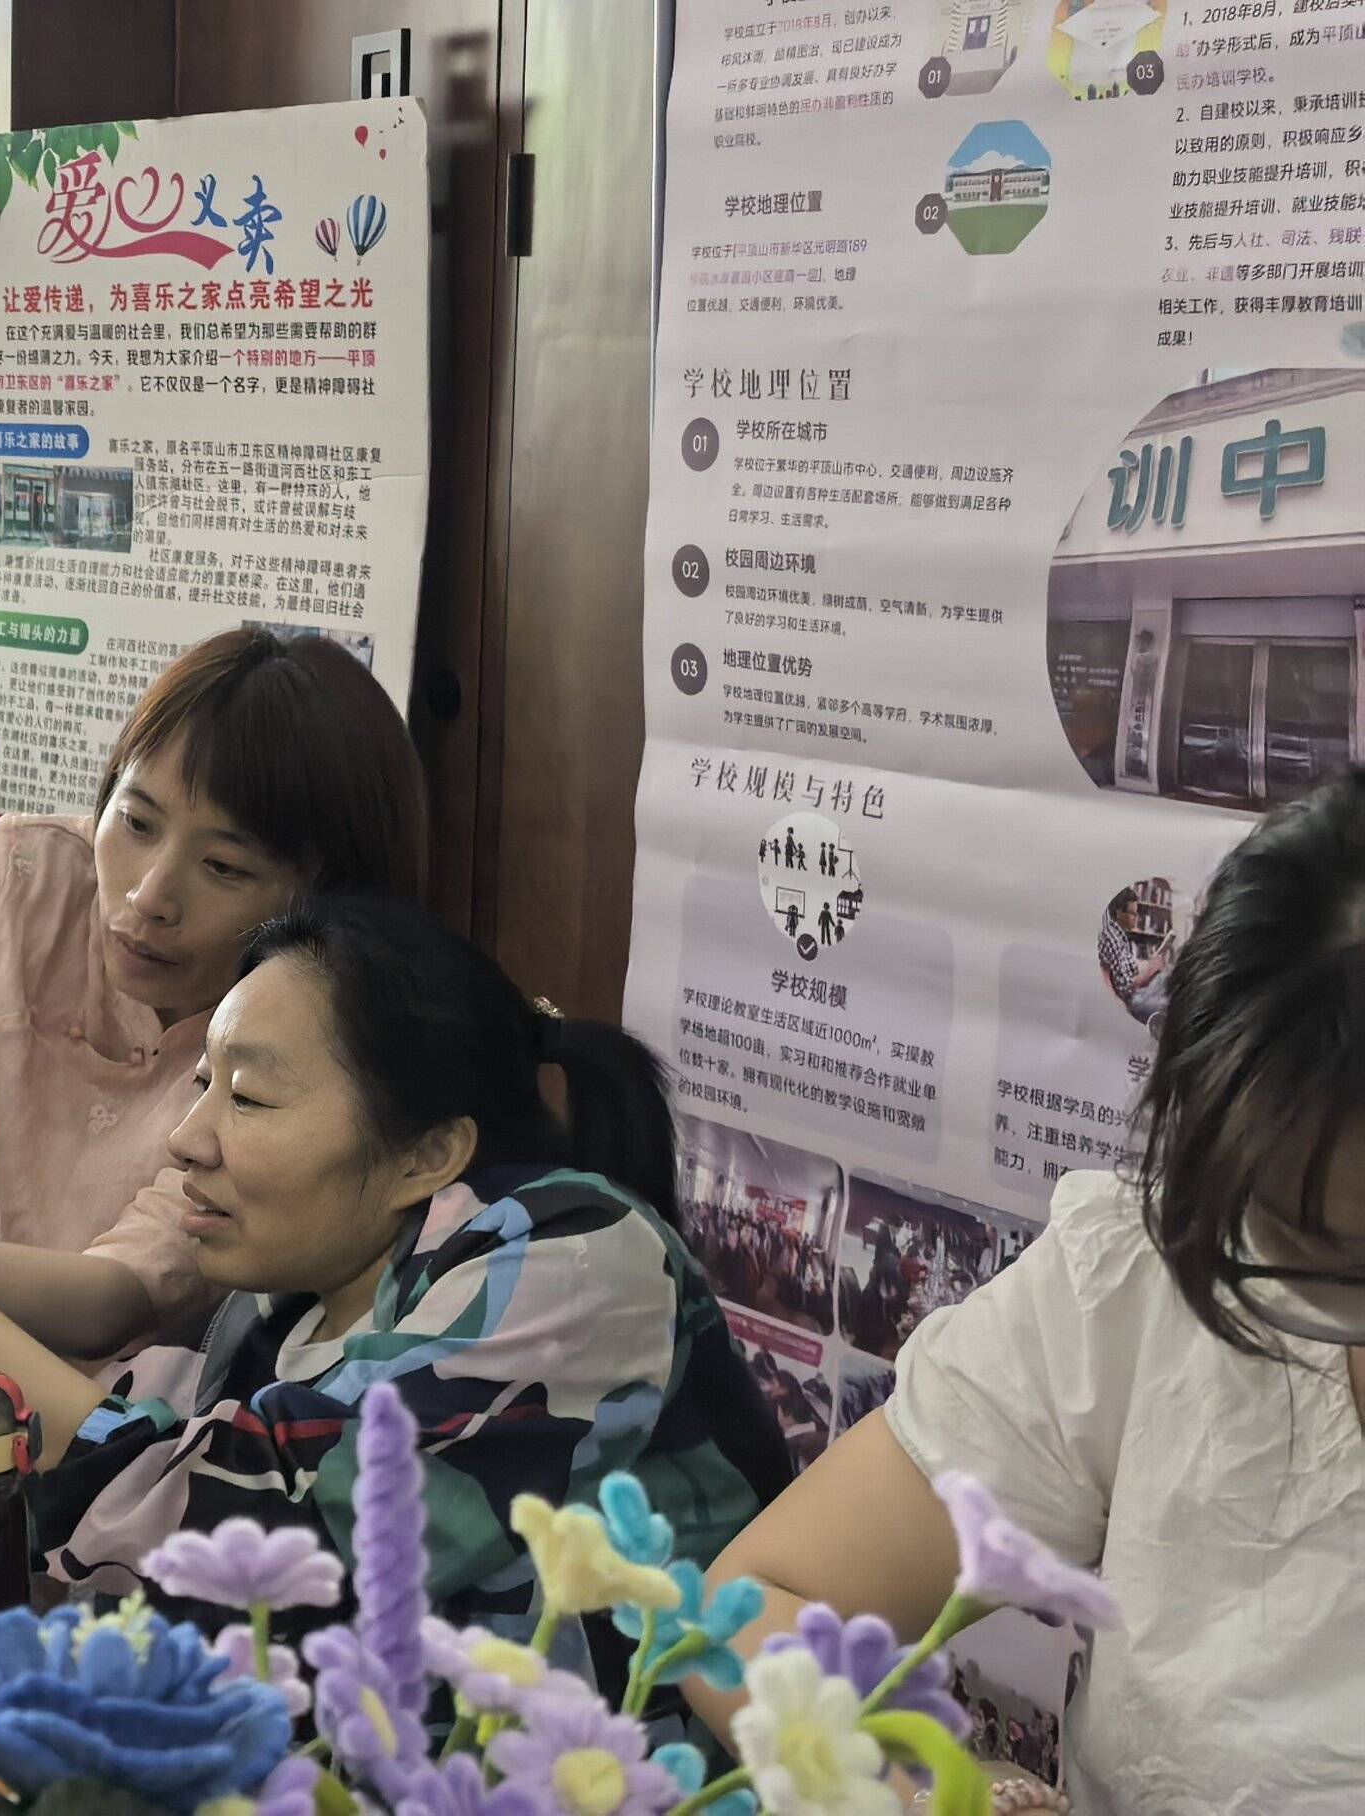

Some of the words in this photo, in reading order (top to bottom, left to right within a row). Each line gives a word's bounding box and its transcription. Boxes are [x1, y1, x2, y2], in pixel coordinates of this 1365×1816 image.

[927, 69, 942, 85] 01
[1136, 64, 1154, 80] 03
[36, 151, 283, 274] 爱心义卖
[725, 189, 823, 217] 学校地理位置
[923, 205, 939, 221] 02
[2, 278, 374, 314] 让爱传递，为喜乐之家点亮希望之光
[1158, 292, 1363, 316] 相关工作，获得丰厚教育培训
[683, 368, 853, 402] 学校地理位置
[736, 418, 829, 442] 学校所在城市
[692, 434, 708, 453] 01
[682, 561, 699, 580] 02
[725, 547, 816, 575] 校园周边环境
[680, 658, 699, 678] 03
[723, 648, 813, 678] 地理位置优势
[691, 757, 886, 820] 学校规模与特色
[771, 968, 848, 1011] 学校规模
